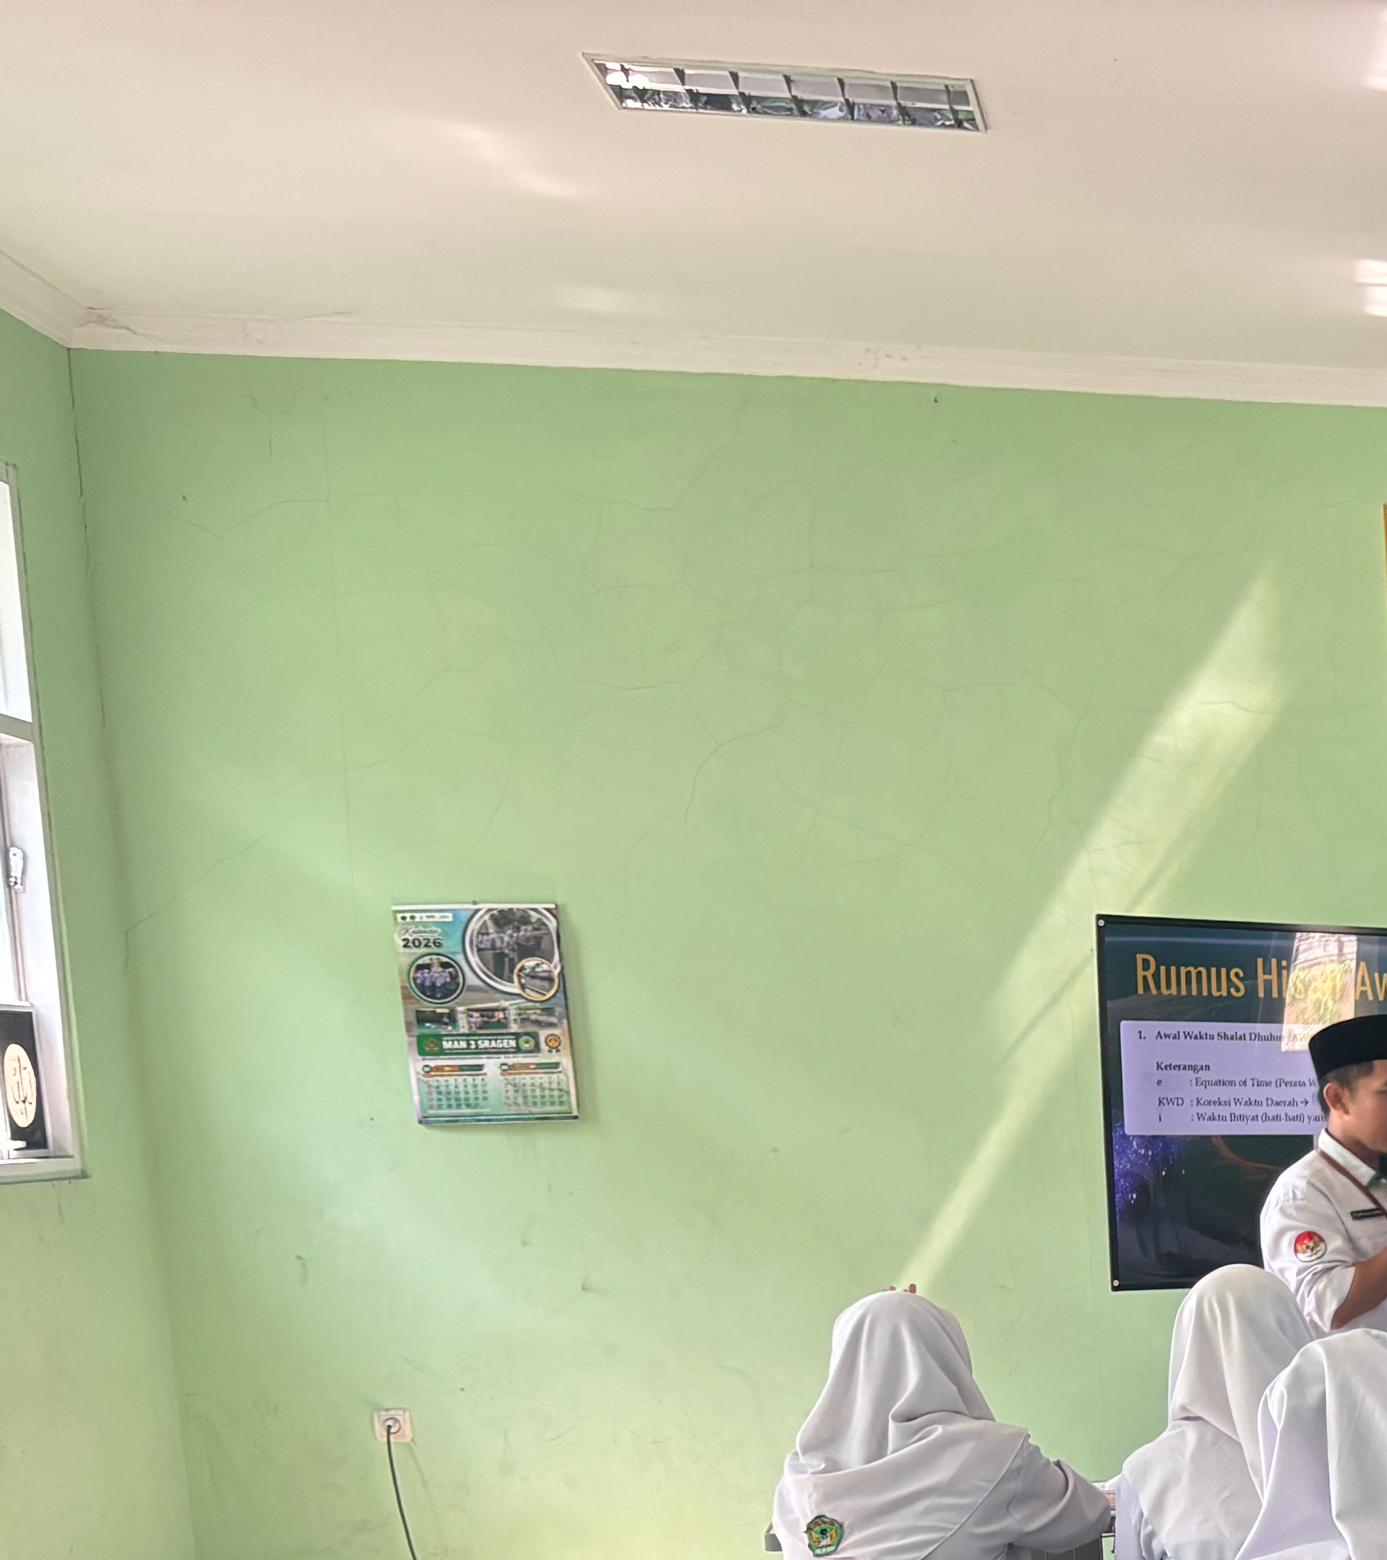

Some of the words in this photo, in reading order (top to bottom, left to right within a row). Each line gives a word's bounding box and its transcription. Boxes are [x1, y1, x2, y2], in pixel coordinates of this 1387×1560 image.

[402, 937, 443, 949] 2026
[1135, 953, 1246, 998] Rumus
[1155, 1029, 1181, 1041] Awal
[1183, 1030, 1215, 1041] Waktu
[1216, 1031, 1247, 1042] Shalat
[442, 1039, 467, 1049] MAN
[469, 1039, 476, 1049] 3
[478, 1039, 517, 1049] SRAGEN
[1156, 1061, 1211, 1073] Keterangan
[1194, 1078, 1237, 1089] Equation
[1238, 1078, 1248, 1087] of
[1250, 1078, 1273, 1087] Time
[1157, 1097, 1185, 1107] KWD
[1195, 1097, 1231, 1107] Koreksi
[1233, 1097, 1263, 1107] Waktu
[1265, 1097, 1298, 1108] Daerah
[1196, 1113, 1227, 1123] Waktu
[1229, 1113, 1259, 1125] Ihtiyat
